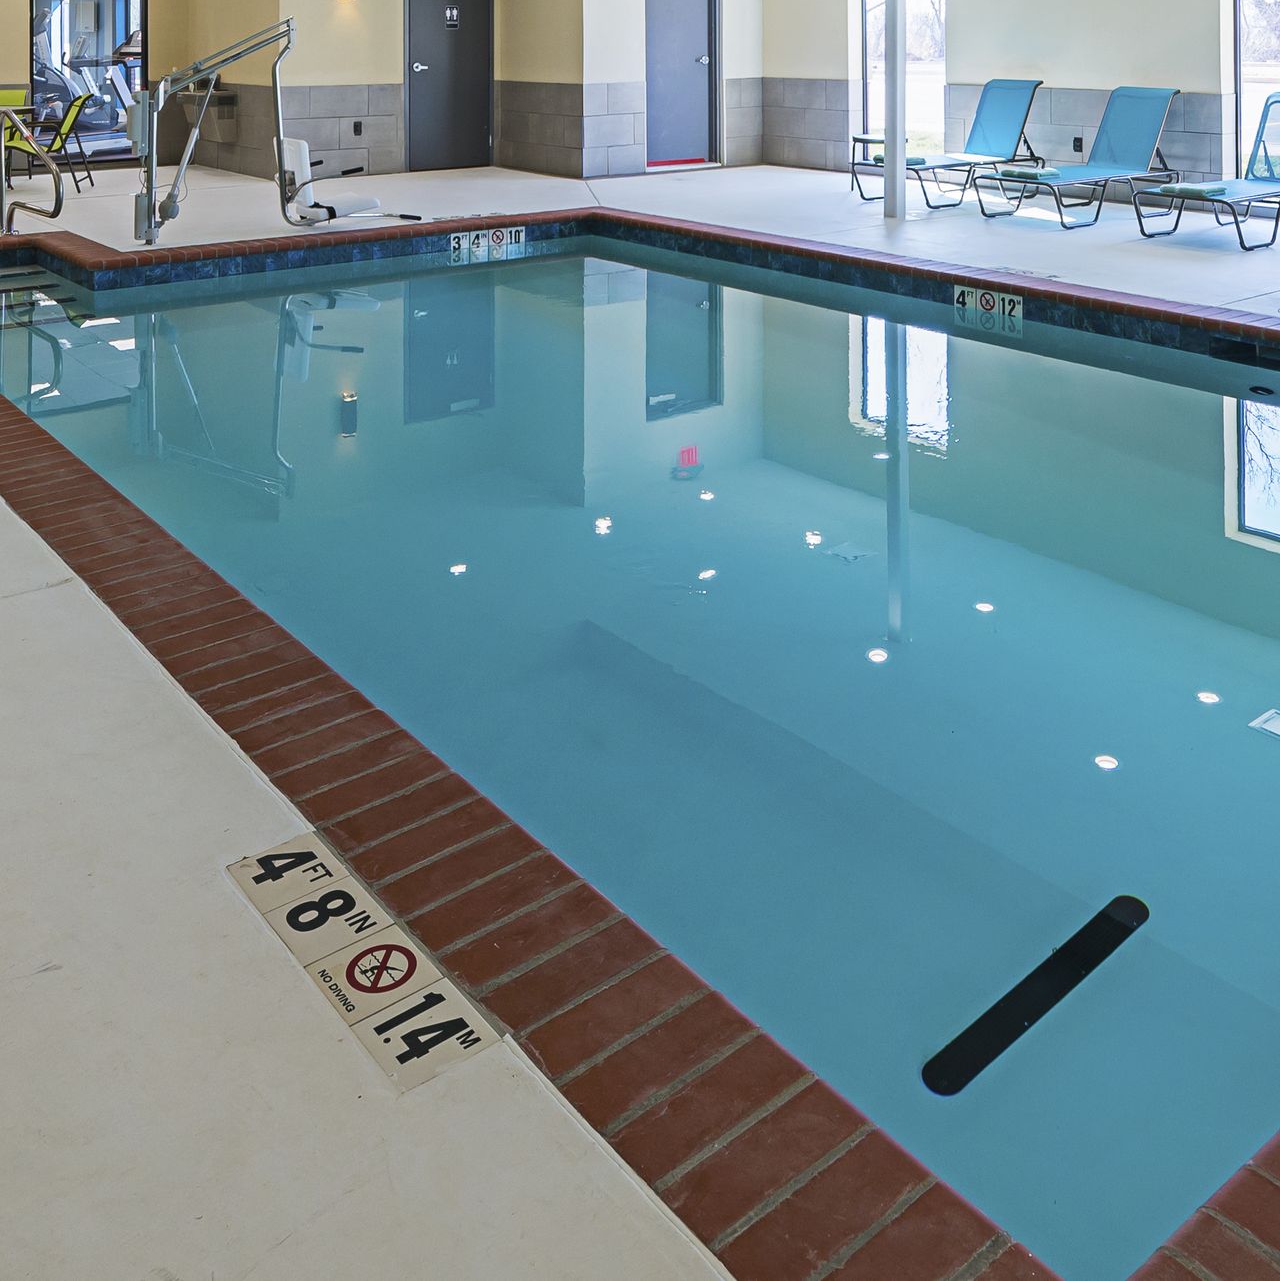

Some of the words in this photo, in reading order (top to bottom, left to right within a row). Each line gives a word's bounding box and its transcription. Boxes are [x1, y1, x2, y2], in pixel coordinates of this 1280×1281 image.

[956, 290, 967, 307] 4
[251, 851, 318, 885] 4
[302, 862, 333, 882] FT
[286, 890, 356, 932] 8
[344, 910, 377, 934] IN
[317, 969, 333, 983] NO
[328, 983, 355, 1013] DIVING
[455, 1029, 482, 1050] M
